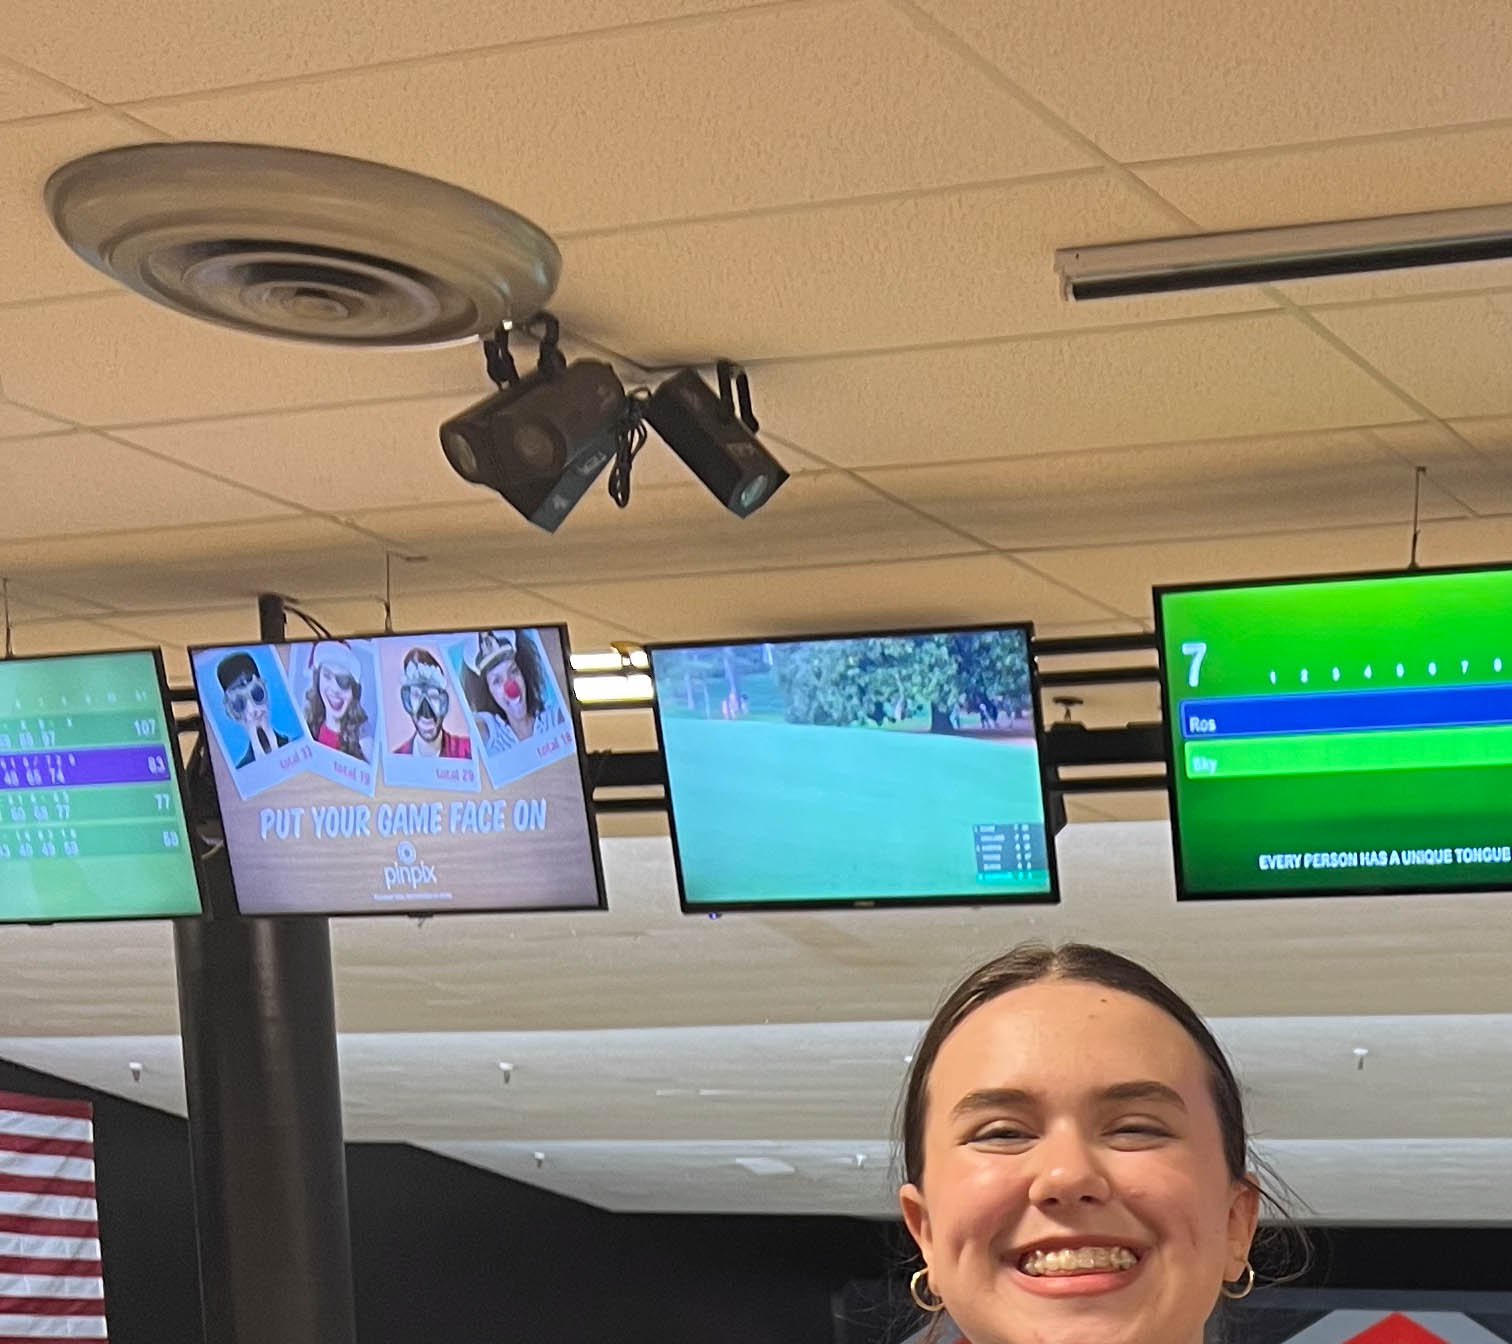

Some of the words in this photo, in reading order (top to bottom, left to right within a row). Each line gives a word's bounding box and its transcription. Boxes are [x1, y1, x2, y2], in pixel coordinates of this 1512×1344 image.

[1182, 642, 1208, 688] 7
[134, 718, 156, 737] 107
[333, 761, 357, 781] total
[436, 767, 461, 781] total
[259, 807, 305, 840] PUT
[310, 804, 371, 840] YOUR
[377, 801, 443, 837] GAME
[449, 799, 507, 836] FACE
[513, 797, 547, 832] ON
[1258, 853, 1303, 870] EVERY
[1304, 851, 1358, 869] PERSON
[1360, 850, 1388, 866] HAS
[1389, 850, 1401, 865] A
[1401, 848, 1453, 866] UNIQUE
[1454, 846, 1512, 864] TONGUE
[384, 860, 438, 890] pinpix
